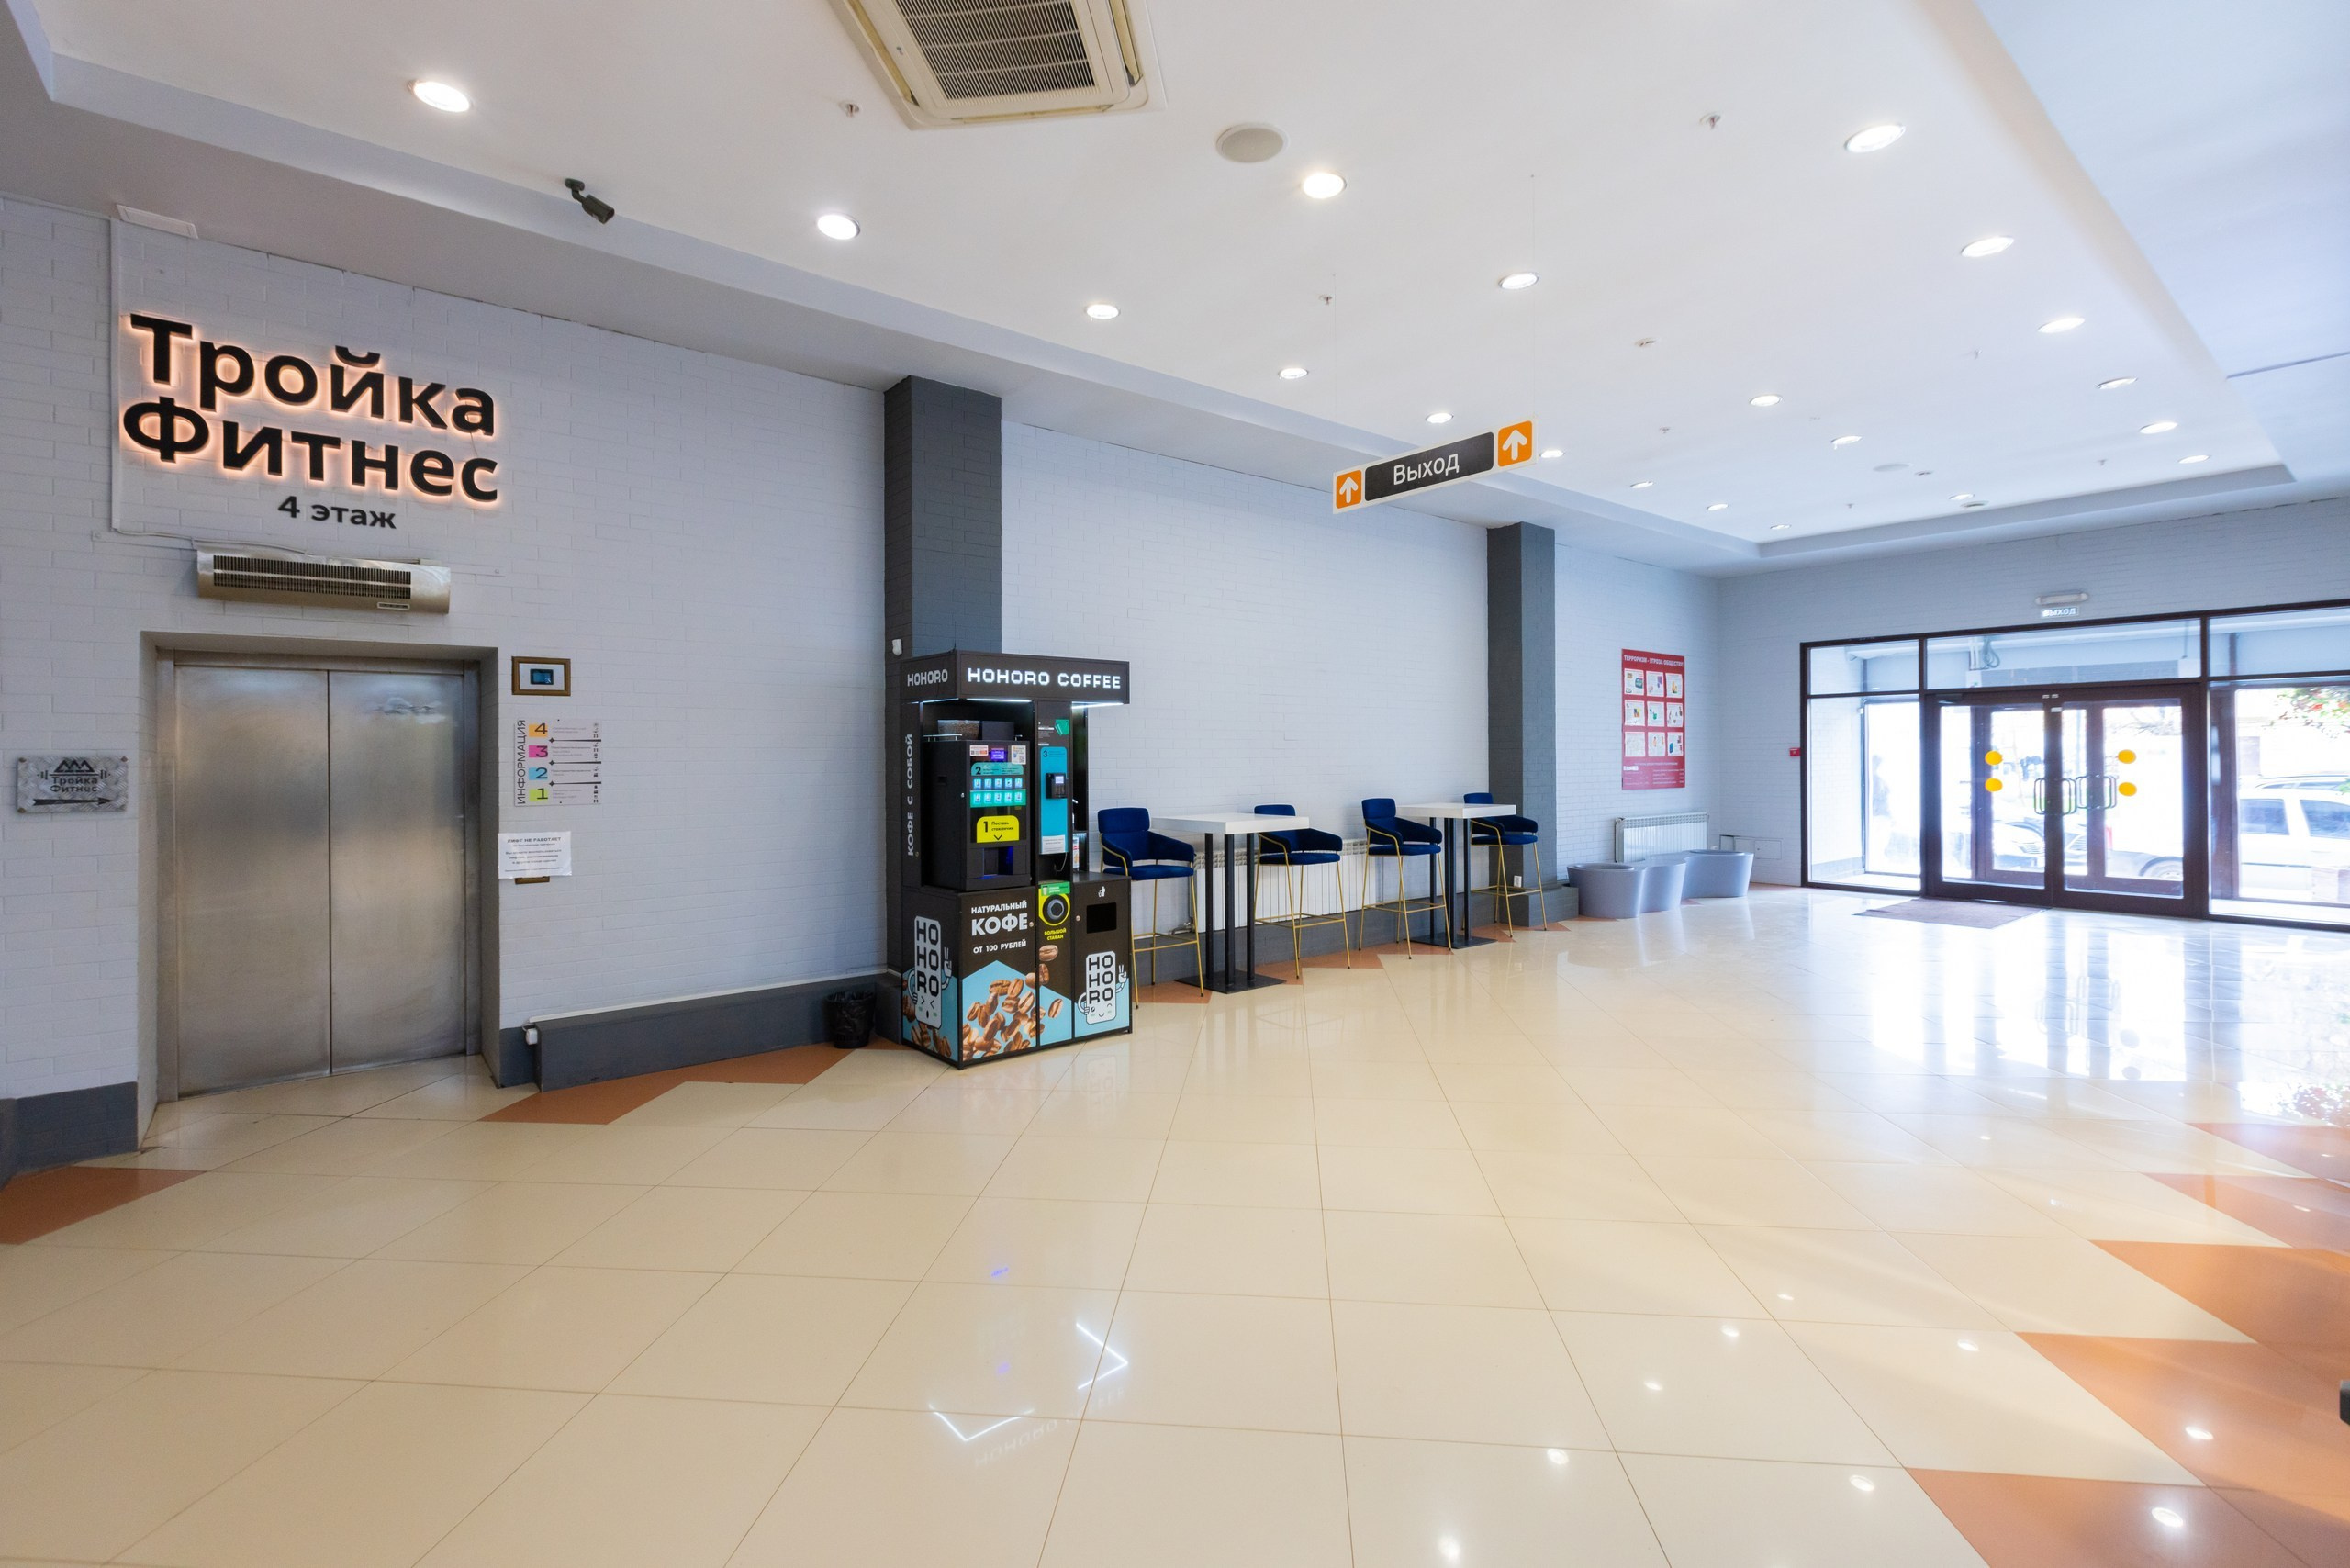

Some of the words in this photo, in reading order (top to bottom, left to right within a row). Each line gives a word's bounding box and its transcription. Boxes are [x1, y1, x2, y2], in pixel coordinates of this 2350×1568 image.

[130, 313, 495, 437] Тройка
[123, 396, 498, 502] Фитнес
[1393, 453, 1460, 486] Выход
[277, 496, 301, 519] 4
[310, 503, 397, 530] этаж
[907, 668, 948, 687] HOHORO
[968, 667, 1050, 686] HOHORO
[1058, 672, 1121, 689] COFFEE
[534, 722, 548, 734] 4
[535, 745, 548, 758] 3
[1042, 750, 1048, 758] 3
[517, 720, 526, 804] ИНФОРМАЦИЯ
[905, 734, 913, 789] СОБОЙ
[535, 767, 548, 779] 2
[975, 766, 981, 775] 2
[51, 777, 98, 785] Тройка
[536, 788, 548, 800] 1
[983, 821, 989, 833] 1
[970, 900, 1027, 914] НАТУРАЛЬНЫЙ
[916, 920, 939, 946] HO
[971, 913, 1028, 936] КОФЕ
[1044, 927, 1067, 936] БОЛЬШОЙ
[973, 946, 983, 954] ОТ
[985, 944, 999, 952] 100
[1000, 938, 1027, 950] РУБЛЕЙ
[916, 945, 939, 971] HO
[1089, 954, 1113, 971] HO
[916, 969, 939, 998] RO
[1089, 970, 1113, 988] HO
[1089, 987, 1113, 1004] RO
